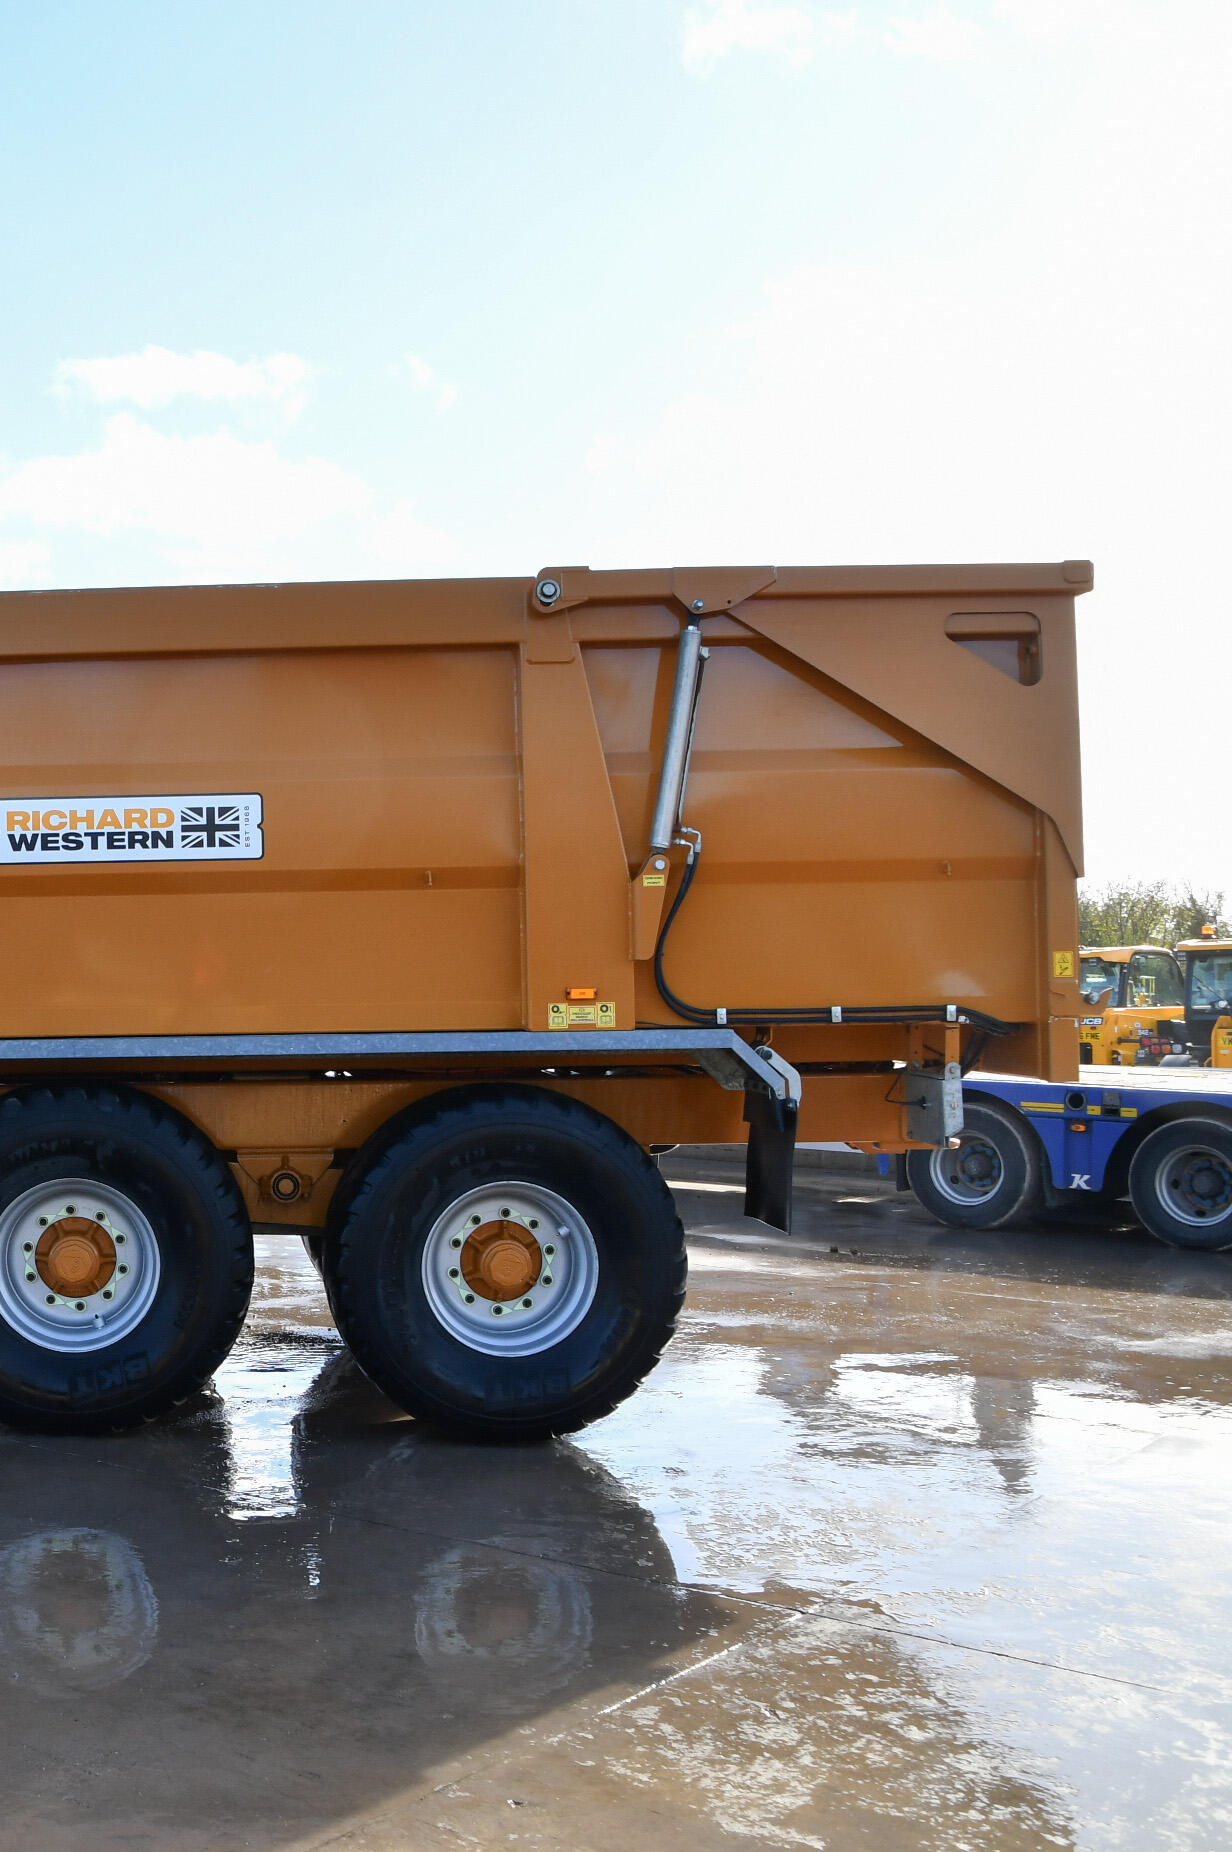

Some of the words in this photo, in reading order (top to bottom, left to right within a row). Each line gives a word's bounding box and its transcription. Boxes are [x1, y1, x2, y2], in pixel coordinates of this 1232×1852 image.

[6, 808, 175, 832] RICHARD
[8, 831, 174, 852] WESTERN
[1080, 1017, 1102, 1025] JCB
